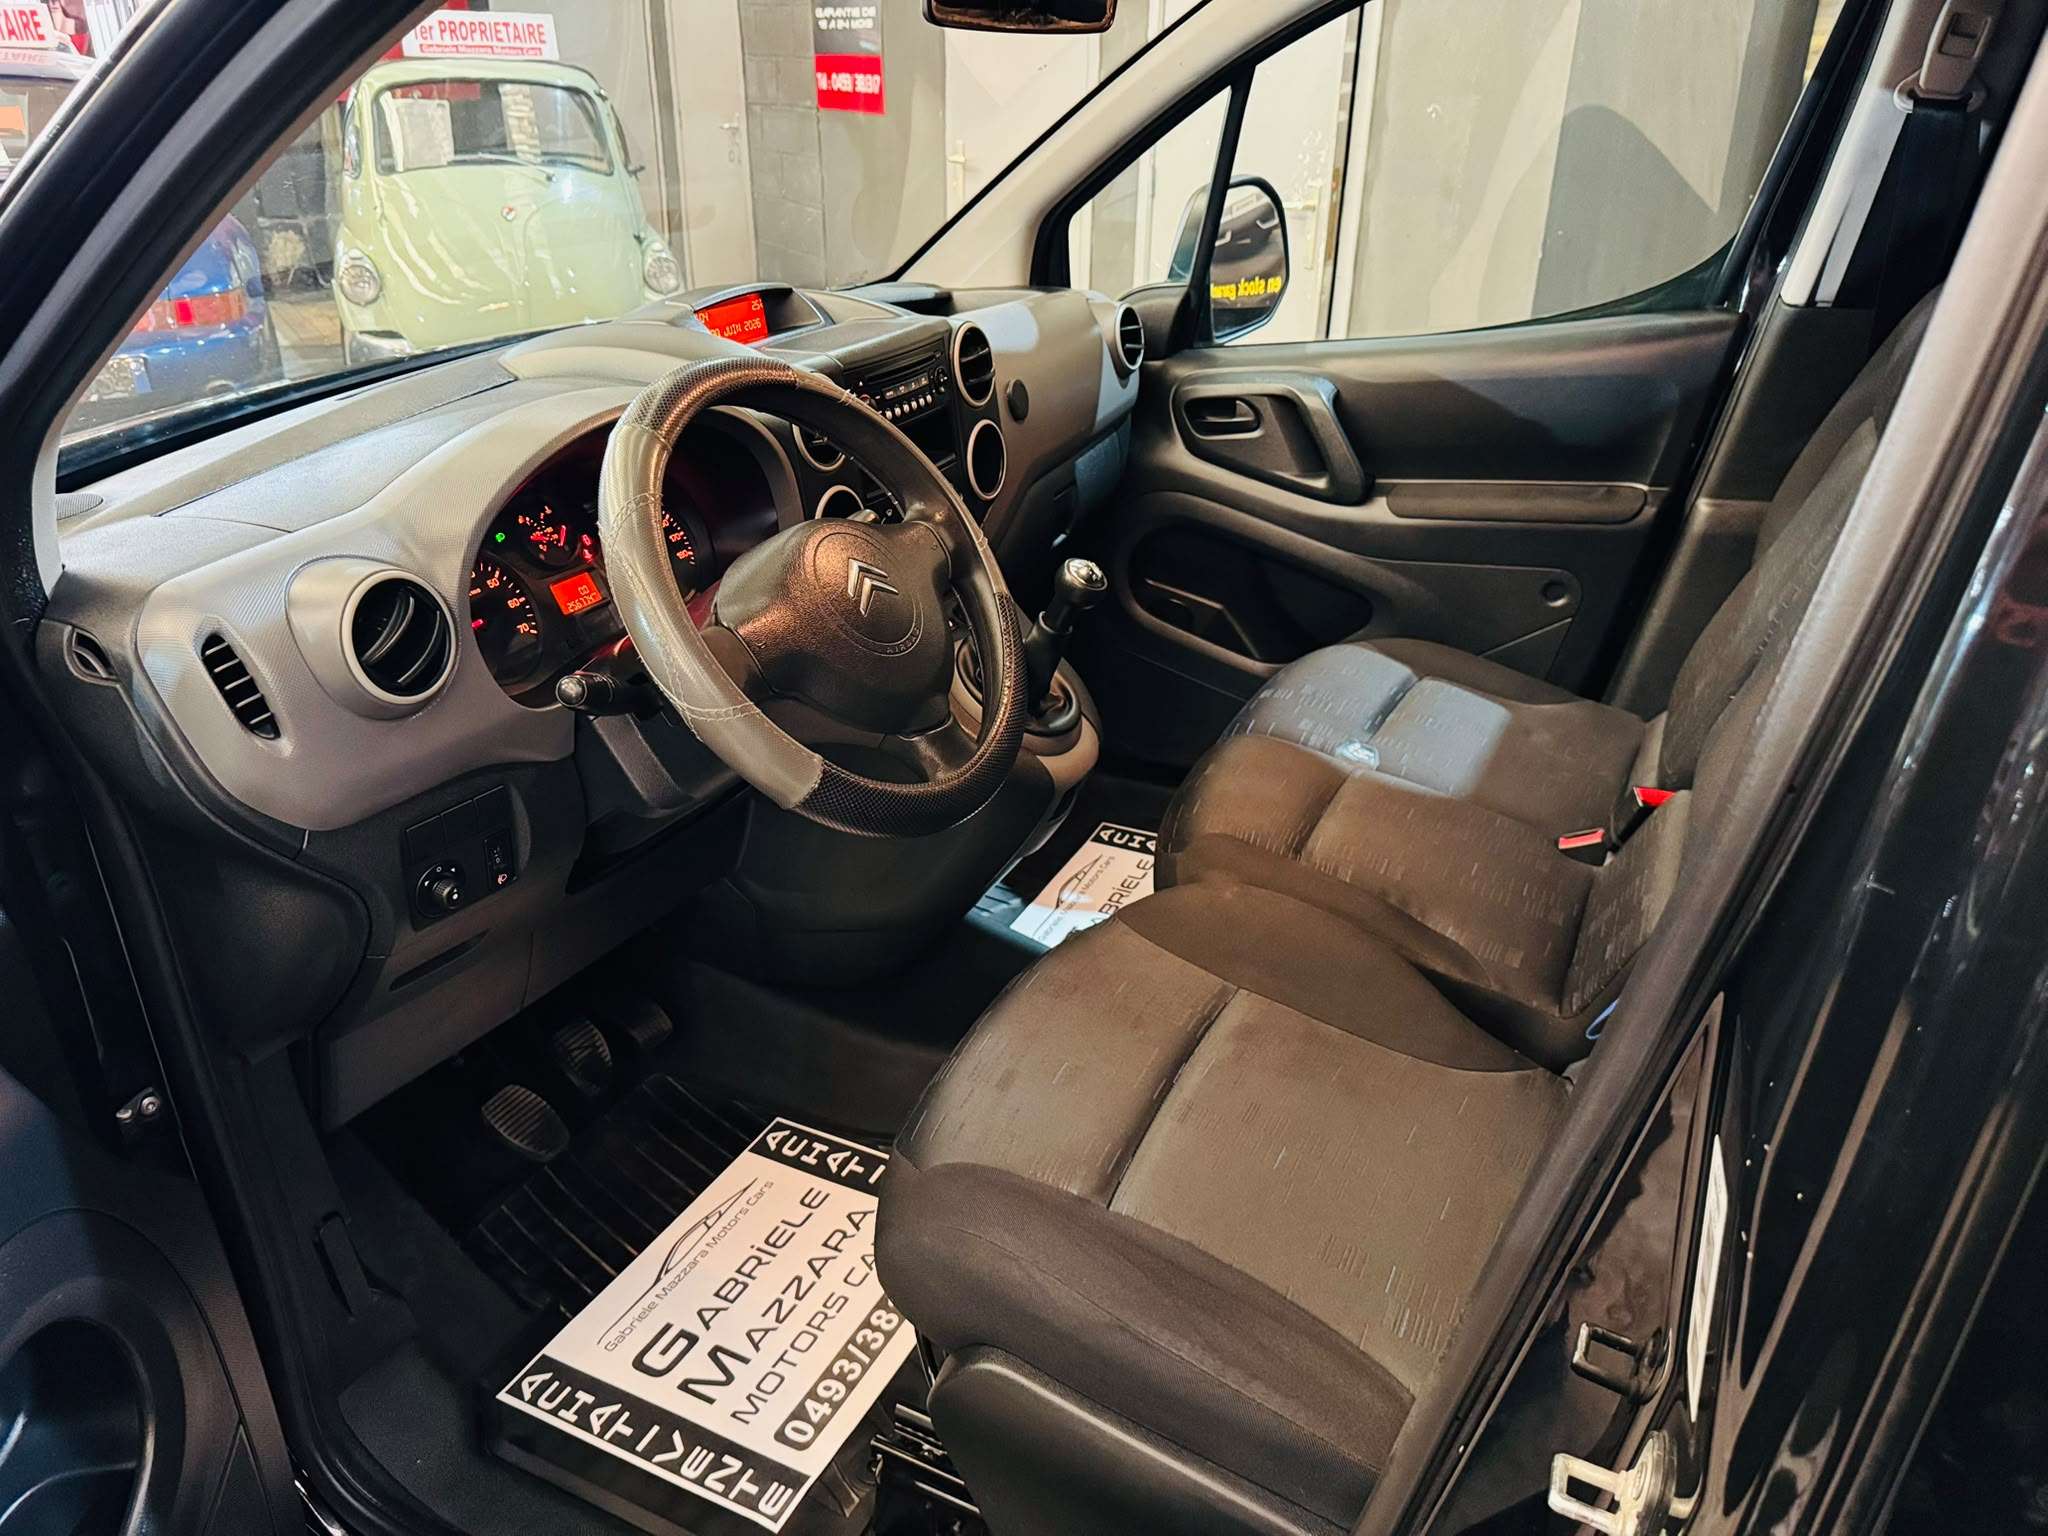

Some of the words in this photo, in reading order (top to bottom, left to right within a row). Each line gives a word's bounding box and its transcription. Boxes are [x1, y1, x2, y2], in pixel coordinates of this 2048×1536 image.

[437, 20, 547, 44] PROPRIETAIRE
[604, 1301, 658, 1352] Gabriele
[655, 1250, 709, 1300] Mazzara
[706, 1208, 750, 1249] Motors
[746, 1181, 774, 1206] Cars
[676, 1208, 876, 1405] MAZZARA
[730, 1291, 849, 1425] MOTORS
[842, 1242, 876, 1288] CA
[783, 1297, 900, 1445] 0493/38
